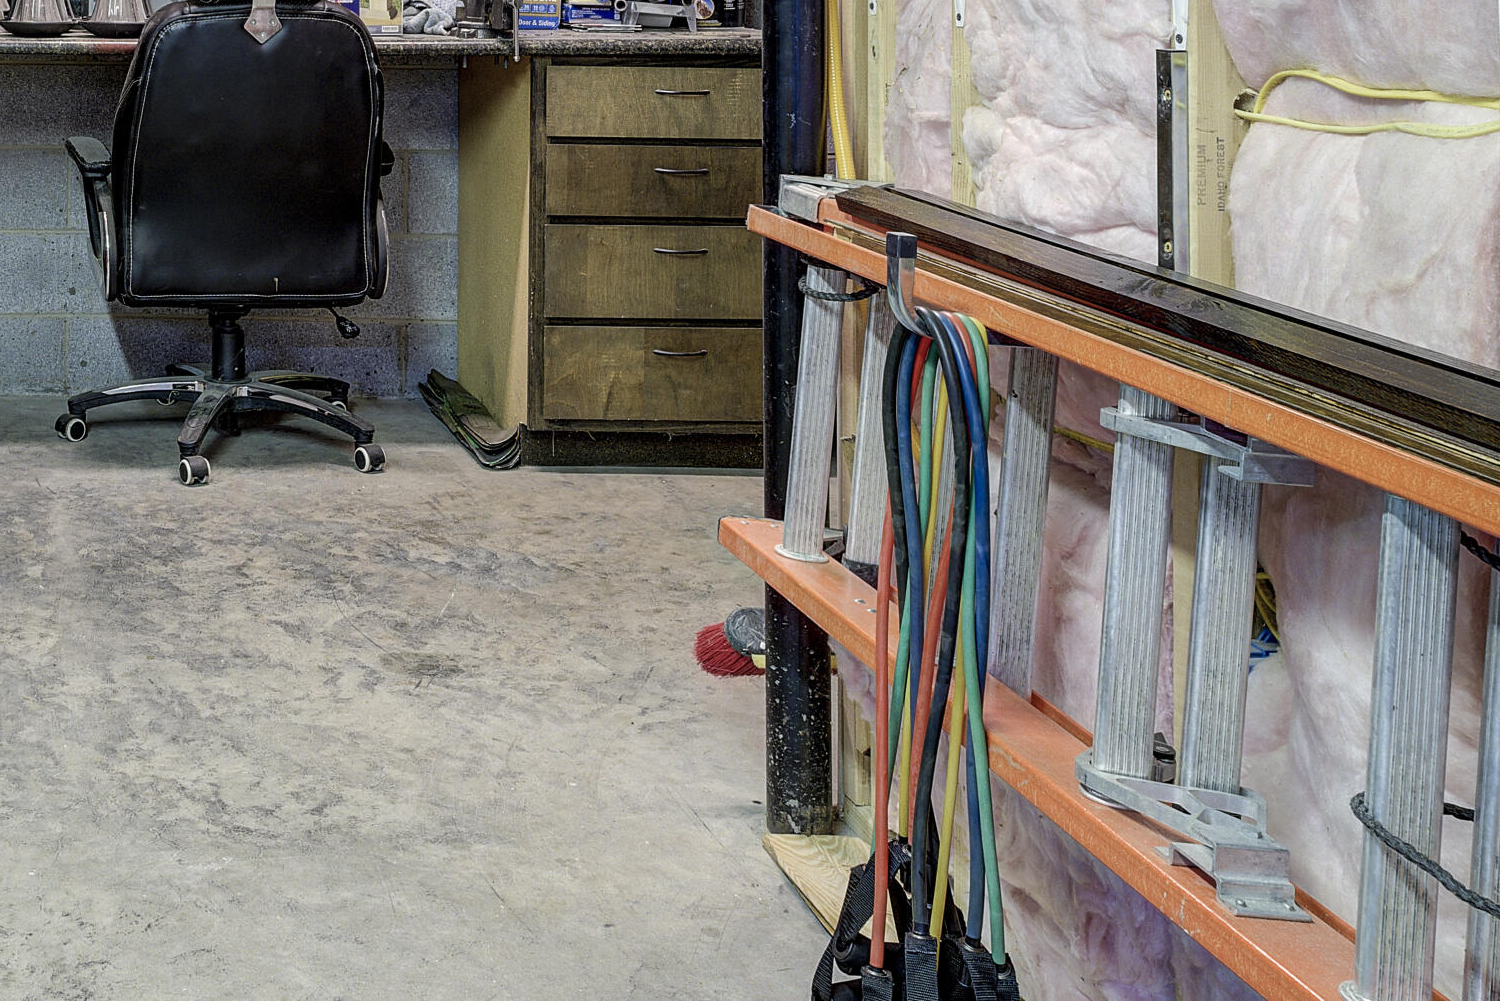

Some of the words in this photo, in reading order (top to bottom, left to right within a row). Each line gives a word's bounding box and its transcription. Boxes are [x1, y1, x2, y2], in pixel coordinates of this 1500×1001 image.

[538, 18, 556, 27] Siding
[1196, 144, 1207, 206] PREMIUM
[1216, 136, 1225, 178] FOREST
[1216, 181, 1226, 212] IDAHO
